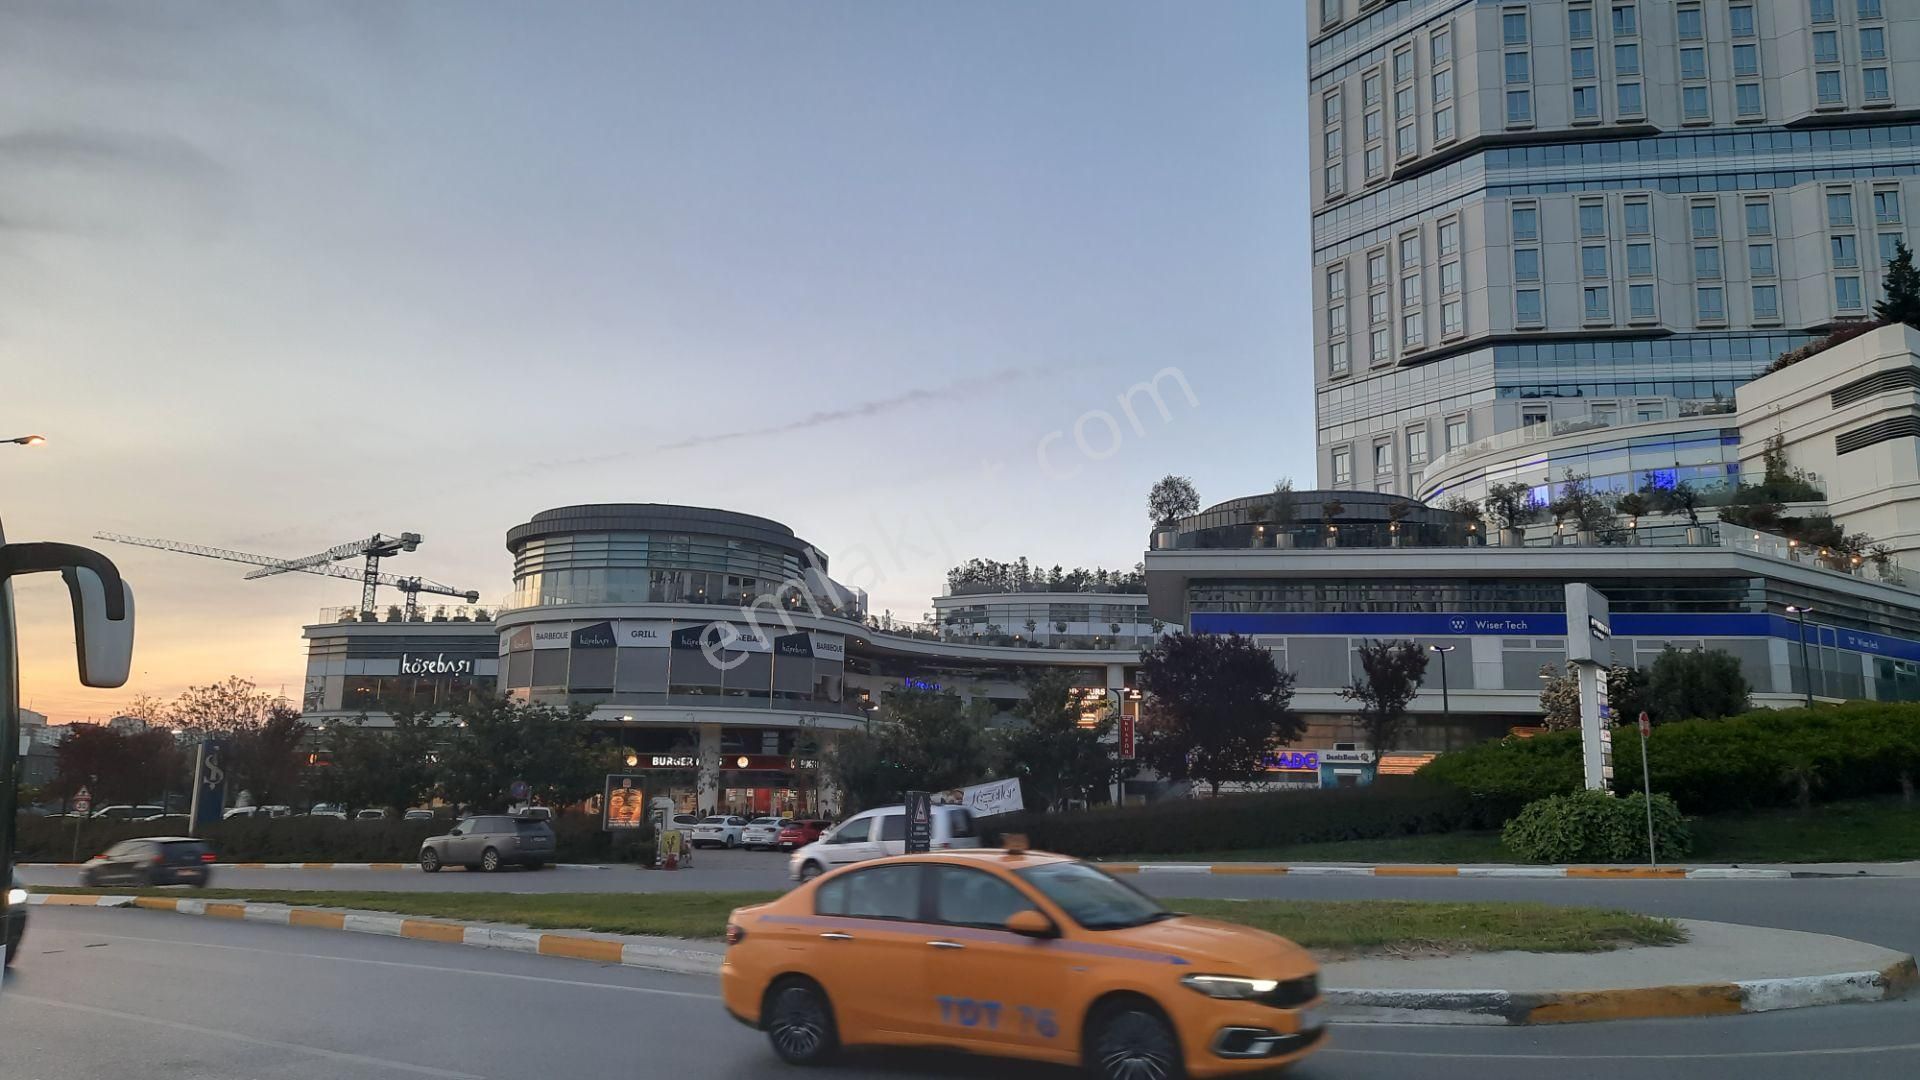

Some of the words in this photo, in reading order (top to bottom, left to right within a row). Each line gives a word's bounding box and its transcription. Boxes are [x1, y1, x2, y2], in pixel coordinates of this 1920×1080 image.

[1475, 620, 1504, 630] Wiser
[1505, 620, 1528, 630] Tech
[536, 631, 569, 640] BARBEQUE
[631, 630, 657, 638] GRILL
[815, 642, 843, 653] BARBEQUE
[652, 756, 694, 766] BURGER
